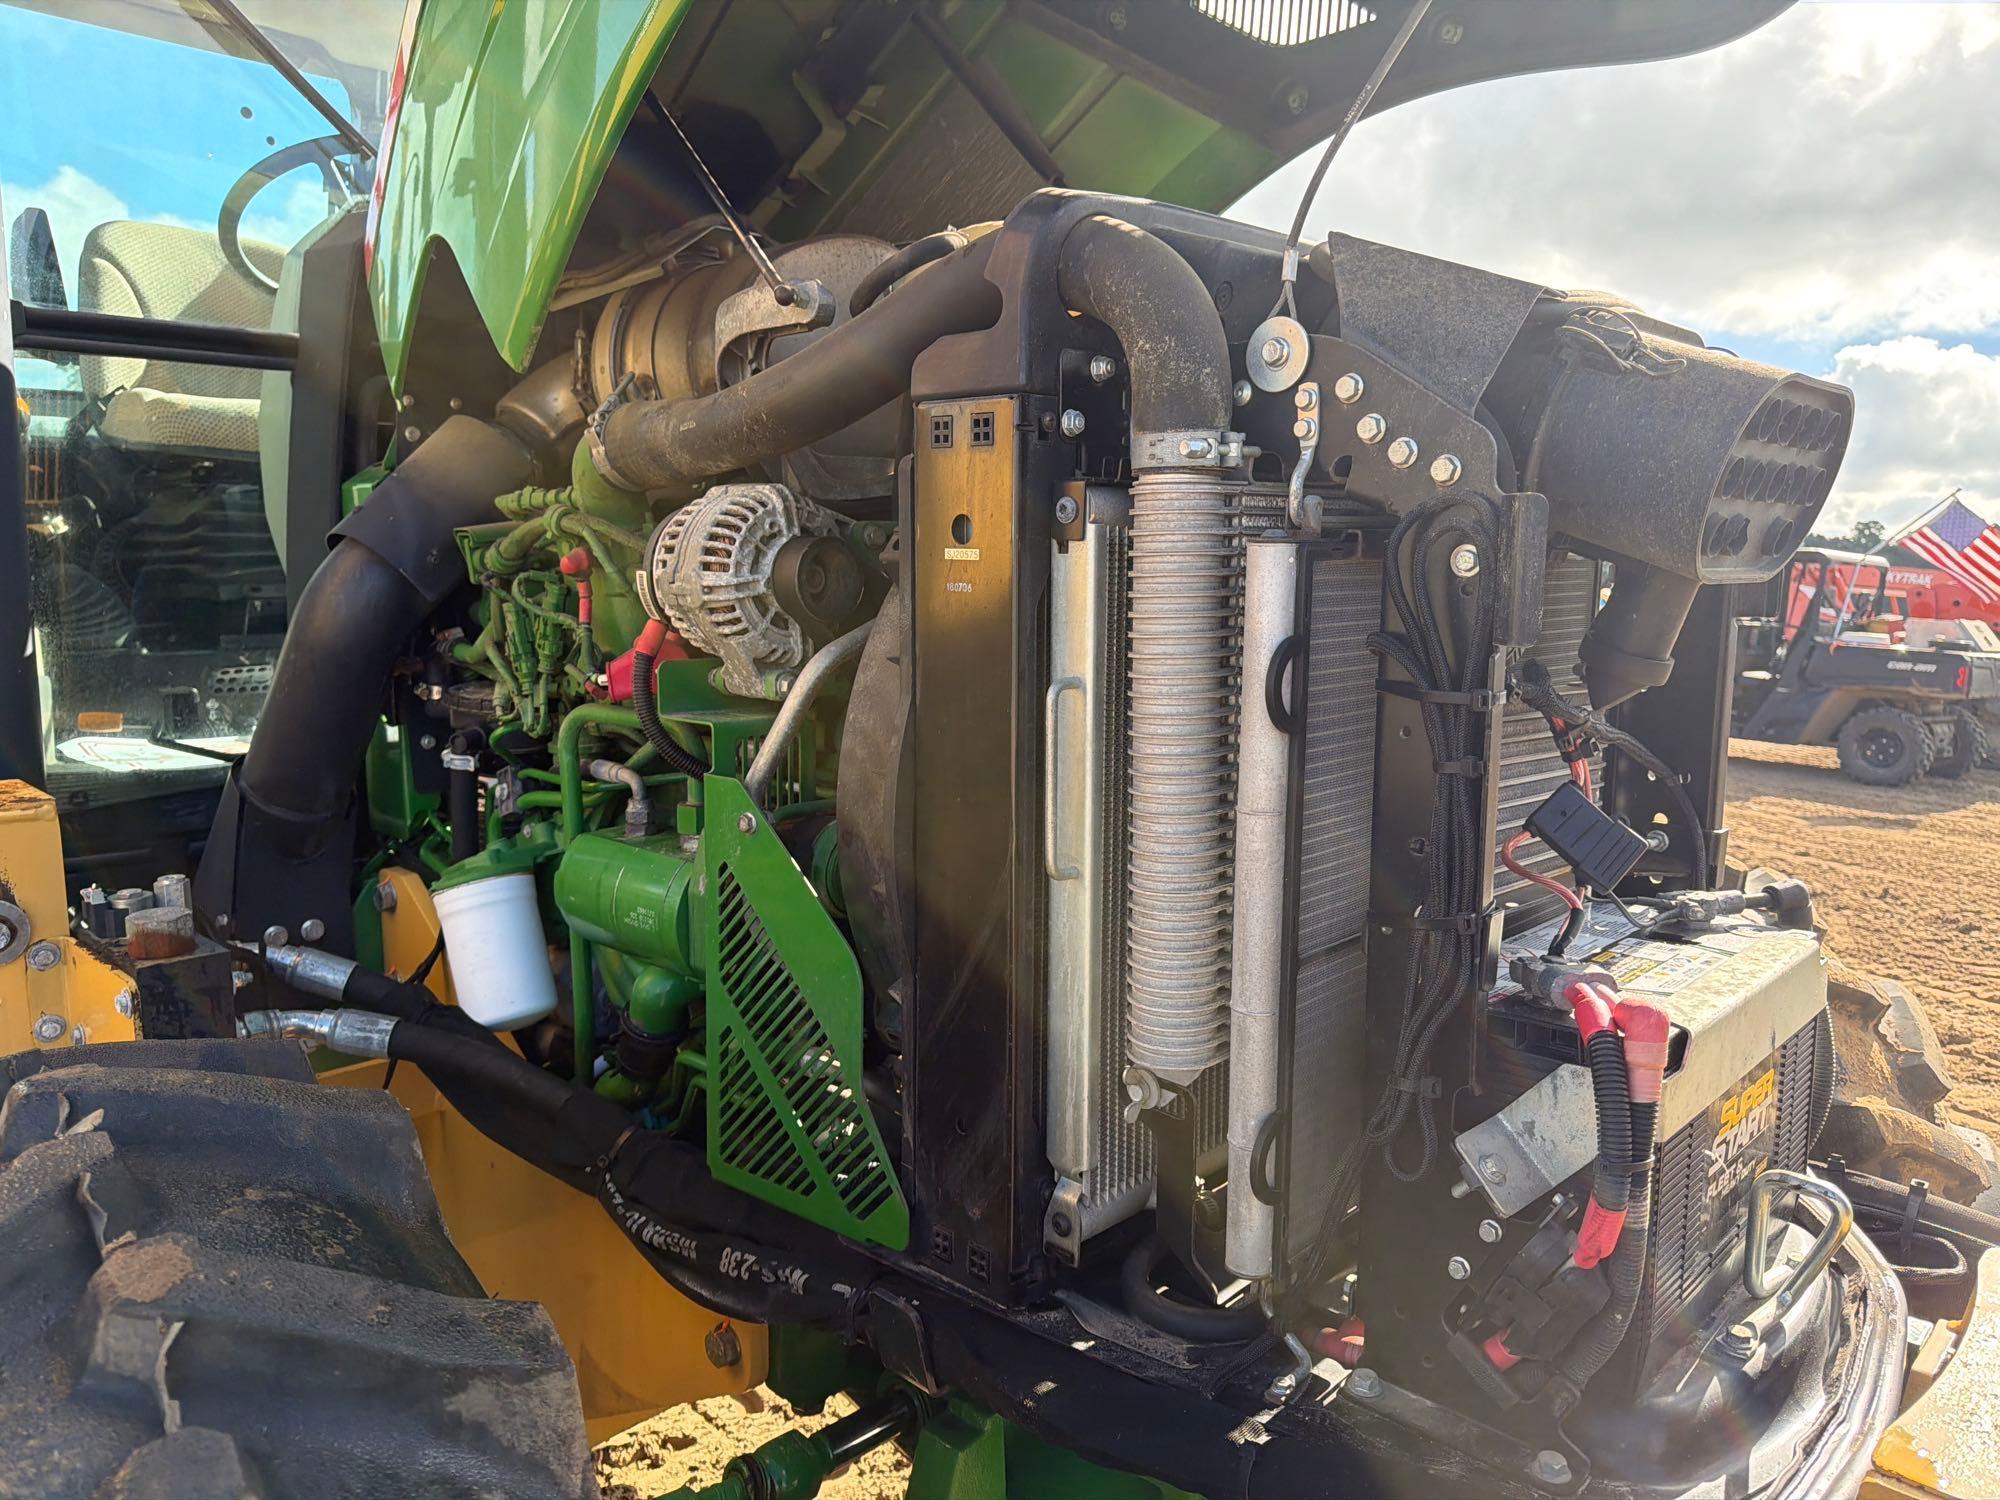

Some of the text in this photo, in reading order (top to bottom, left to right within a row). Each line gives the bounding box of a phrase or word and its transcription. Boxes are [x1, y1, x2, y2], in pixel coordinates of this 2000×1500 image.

[946, 550, 979, 559] SJ20575
[1885, 572, 1932, 585] KYTRAK
[1719, 1068, 1775, 1136] SUPER
[1708, 1093, 1773, 1177] START
